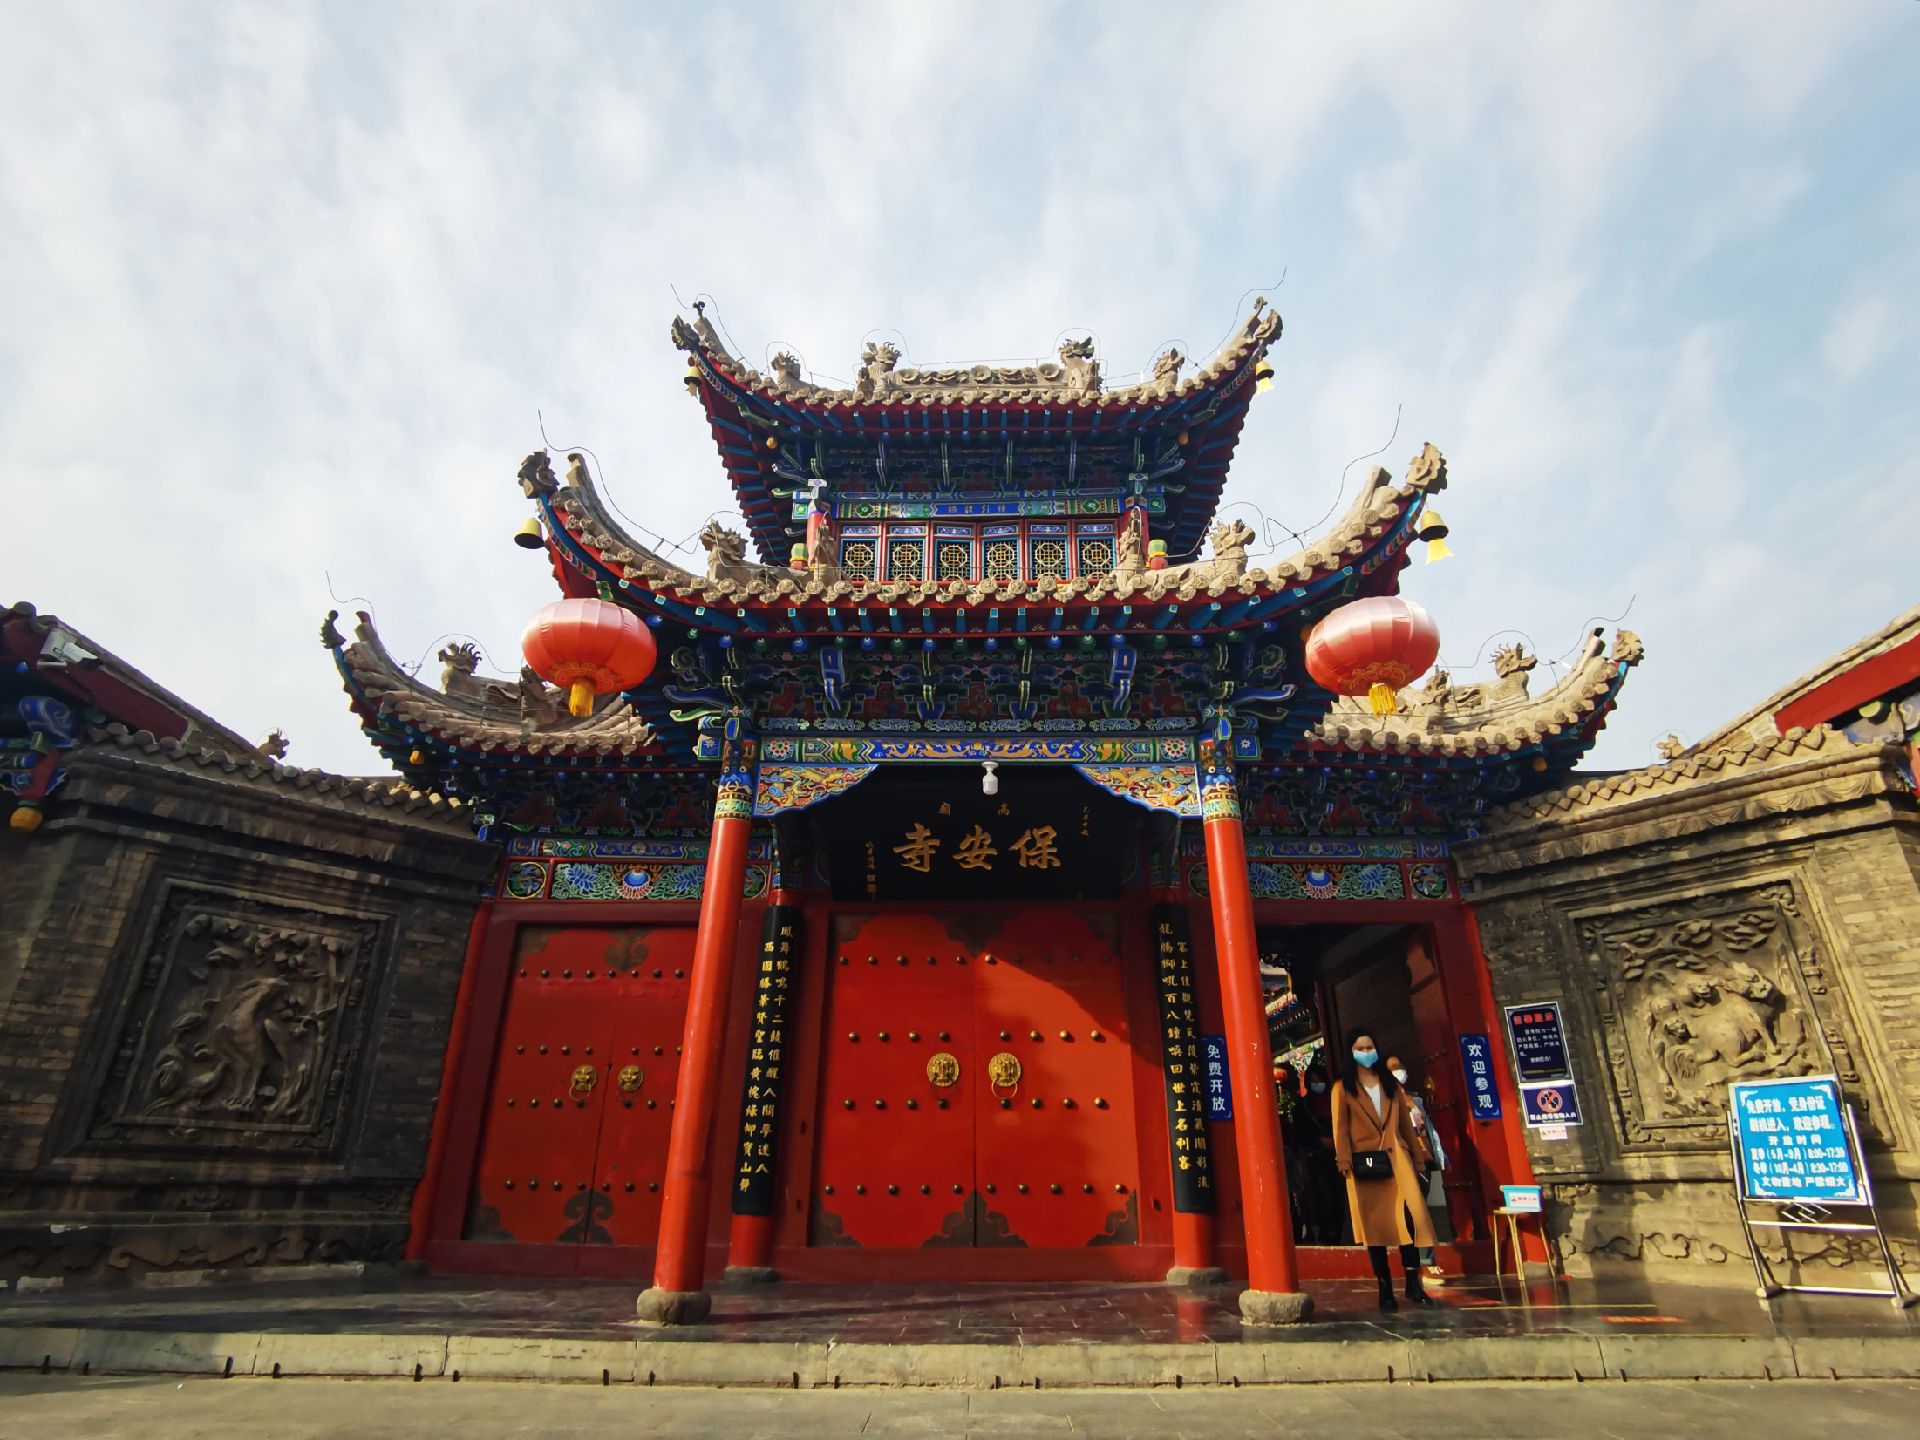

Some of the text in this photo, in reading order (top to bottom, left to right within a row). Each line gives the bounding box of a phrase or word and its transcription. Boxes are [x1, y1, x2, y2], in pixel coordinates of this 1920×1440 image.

[893, 823, 1062, 872] 保安寺
[1207, 1044, 1226, 1111] 免费开放
[1467, 1043, 1494, 1108] 欢迎参观
